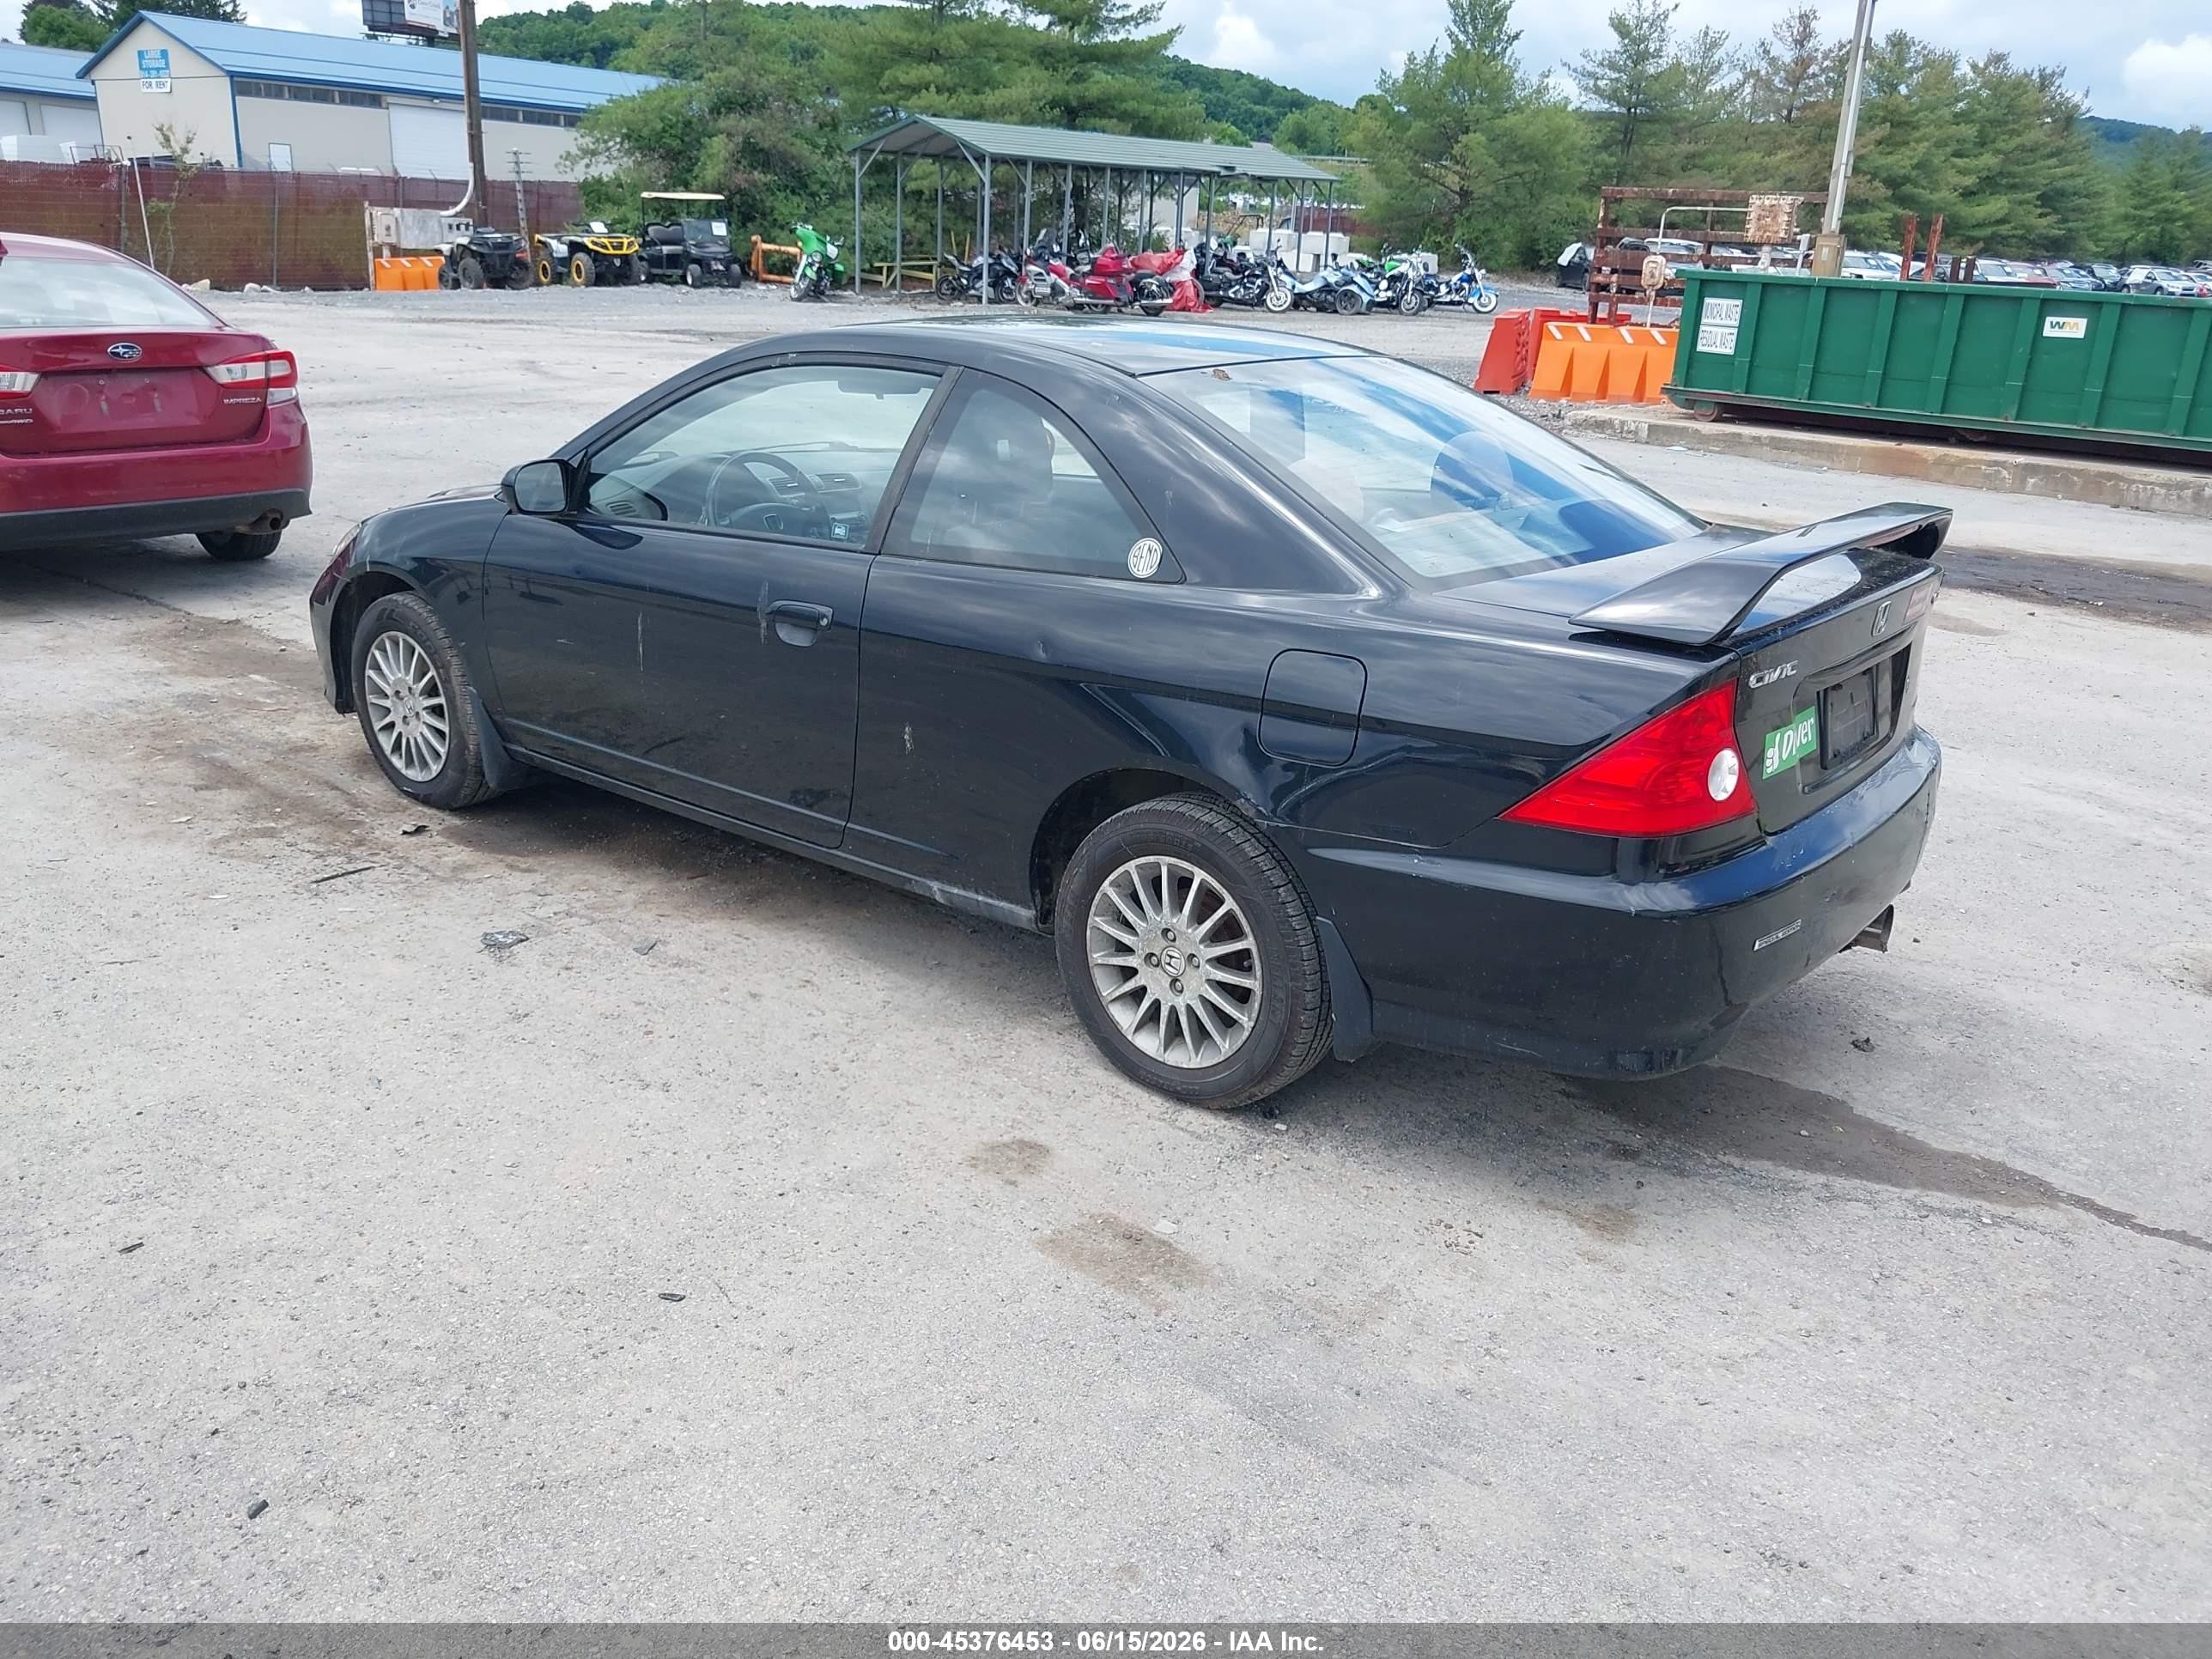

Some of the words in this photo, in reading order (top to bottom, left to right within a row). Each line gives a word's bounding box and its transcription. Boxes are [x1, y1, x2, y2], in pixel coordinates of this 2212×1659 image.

[142, 81, 154, 90] FOR
[155, 81, 169, 89] RENT
[1724, 303, 1740, 322] WASTE
[2050, 320, 2079, 331] WM
[1719, 331, 1735, 350] WASTE
[1748, 660, 1799, 689] CIVIC
